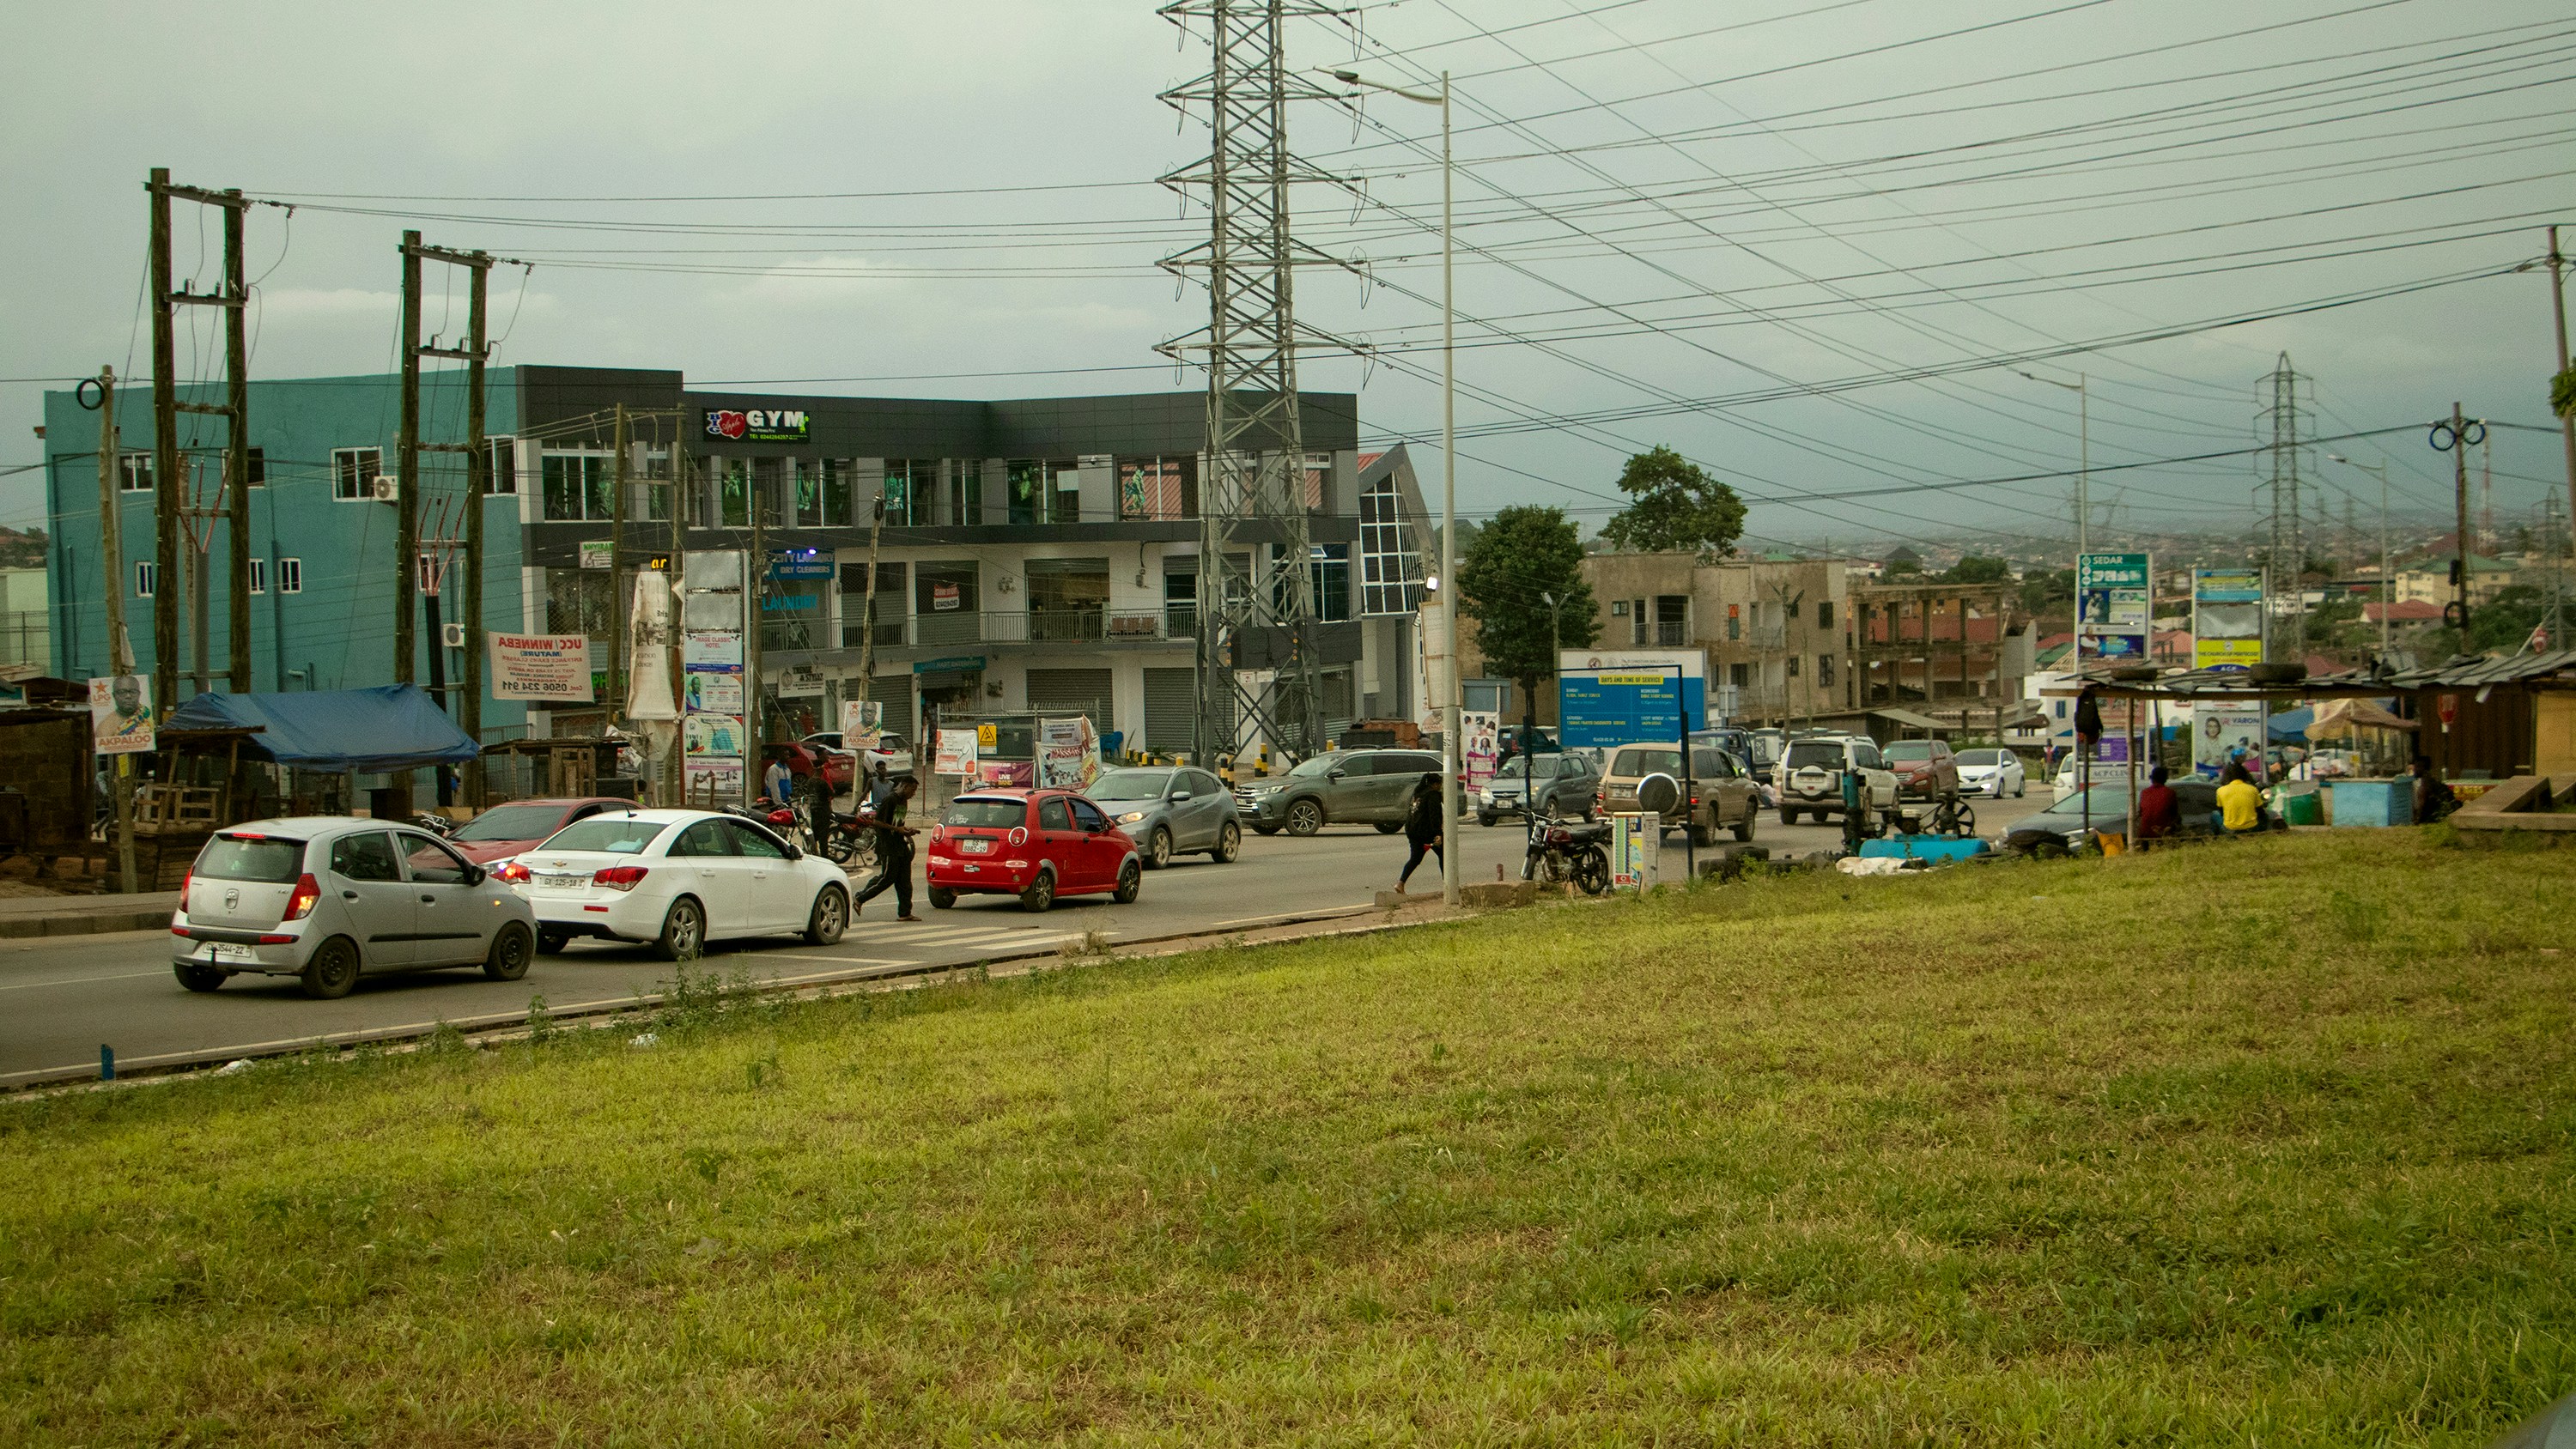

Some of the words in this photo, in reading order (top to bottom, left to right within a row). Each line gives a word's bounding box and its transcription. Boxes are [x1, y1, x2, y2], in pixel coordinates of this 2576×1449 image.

[746, 410, 805, 427] GYM
[2093, 556, 2123, 565] SEDAR
[762, 594, 817, 610] LAUNDRY
[94, 694, 111, 702] LPG
[98, 735, 152, 747] AKPALOO
